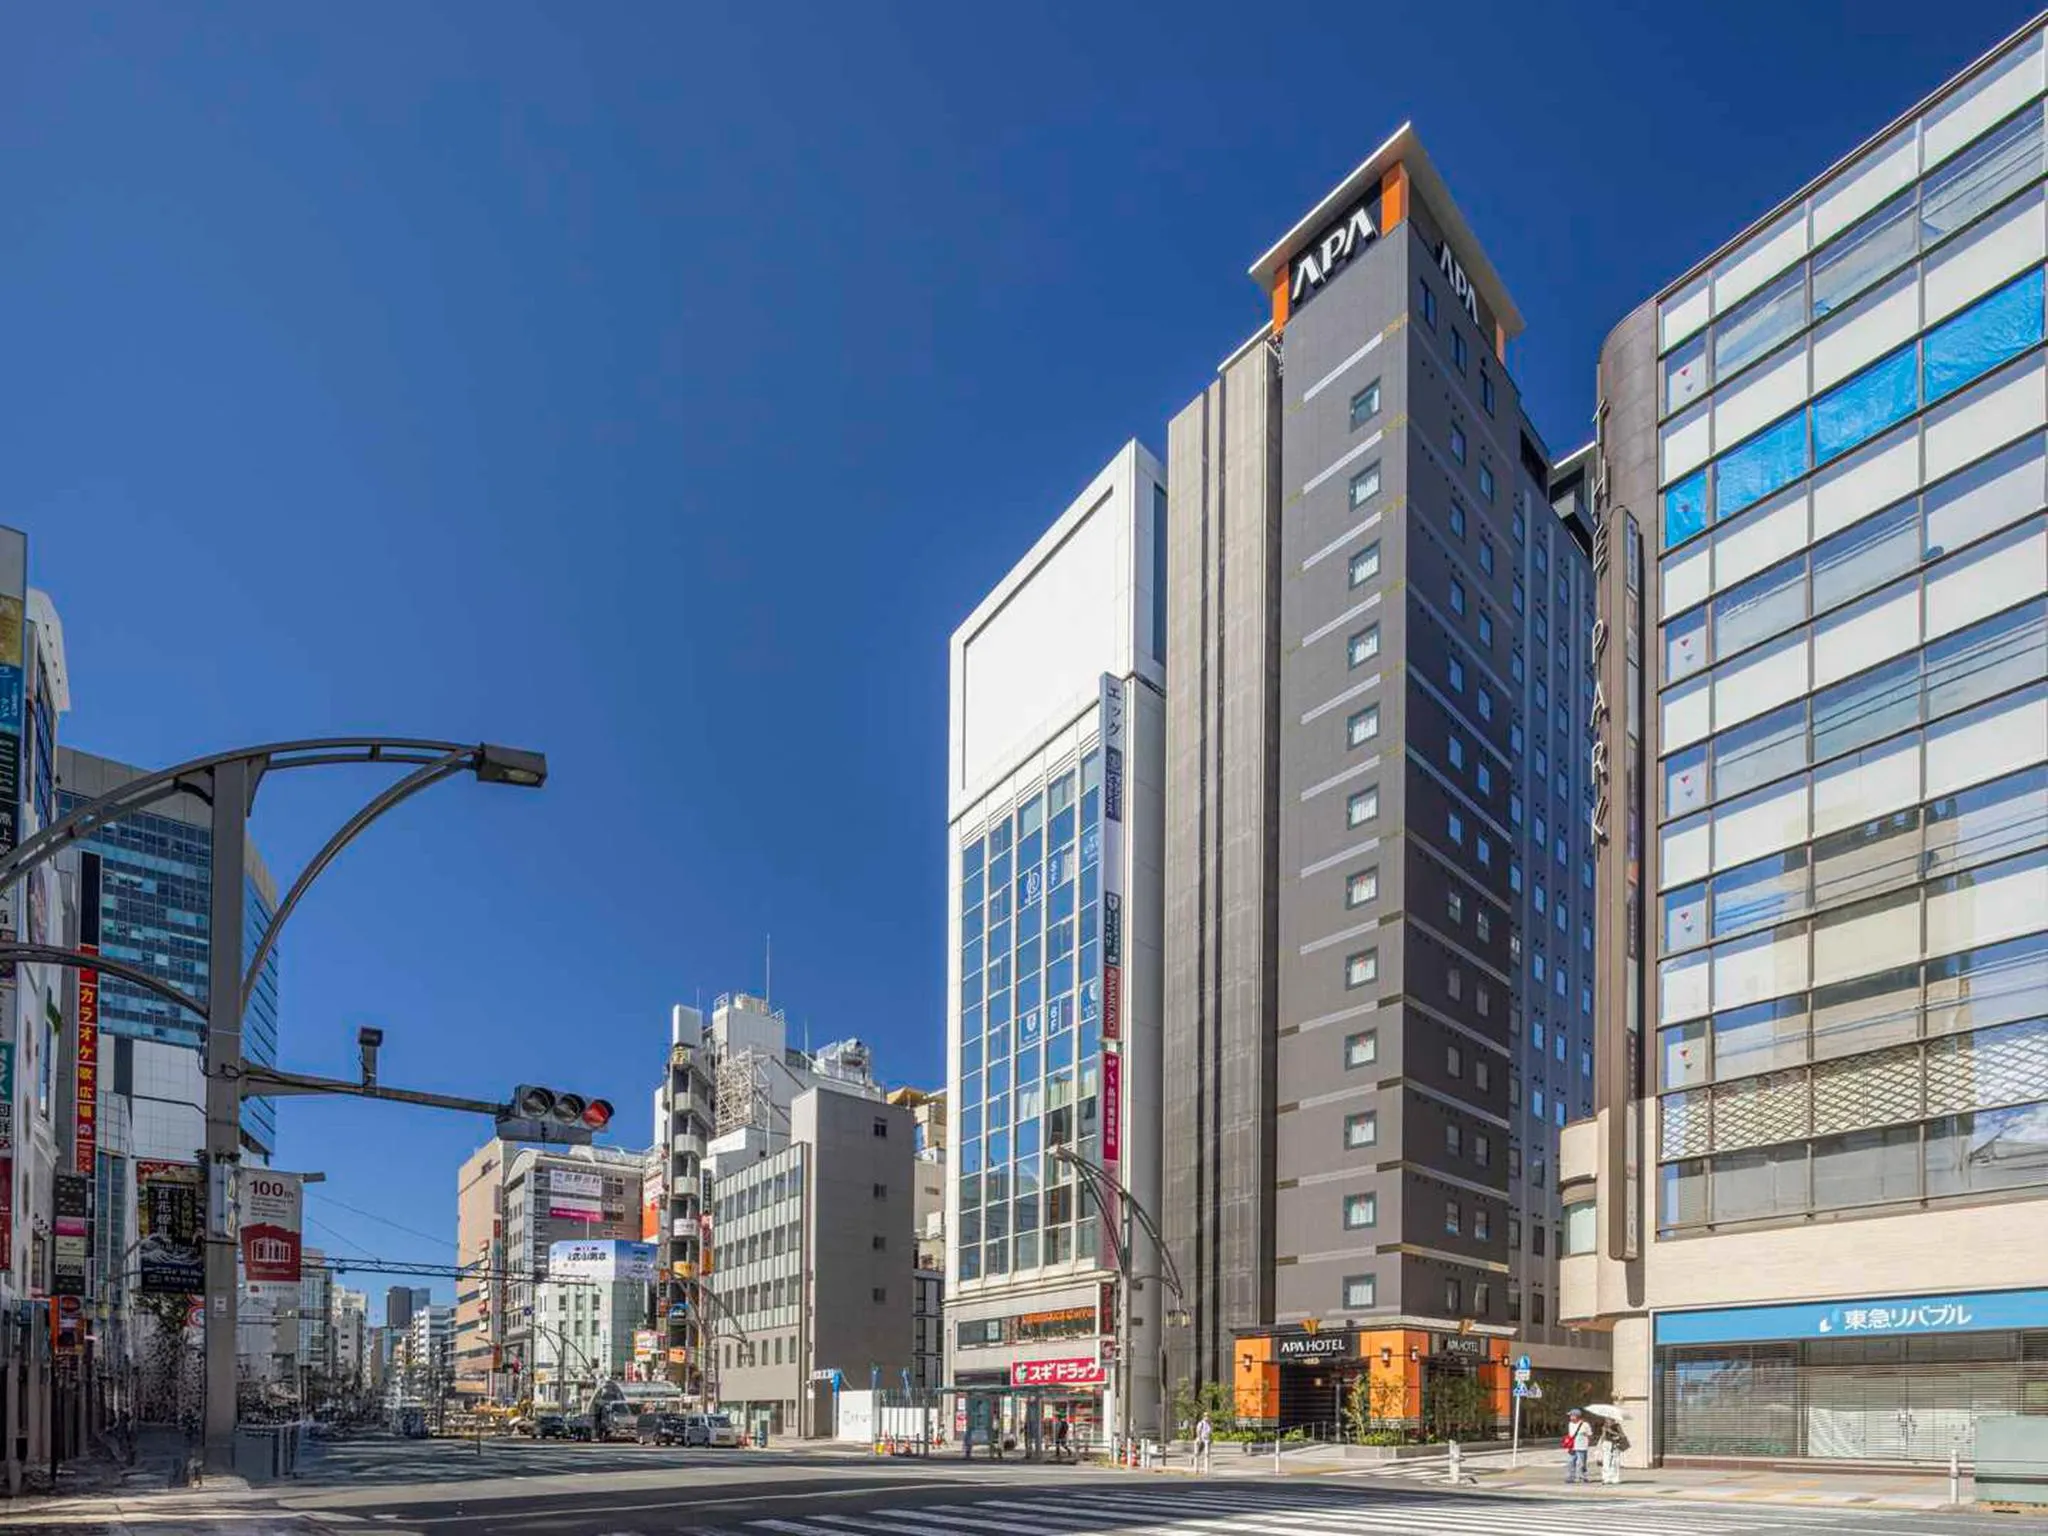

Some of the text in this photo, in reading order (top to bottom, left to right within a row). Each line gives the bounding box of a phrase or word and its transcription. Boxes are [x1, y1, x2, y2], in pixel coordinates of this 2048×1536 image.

[1291, 207, 1378, 300] APA
[1440, 242, 1479, 324] APA
[1590, 619, 1608, 848] PARK
[249, 1180, 284, 1197] 100
[1844, 1304, 1972, 1330] 東急リバブル
[1281, 1339, 1345, 1352] APA HOTEL
